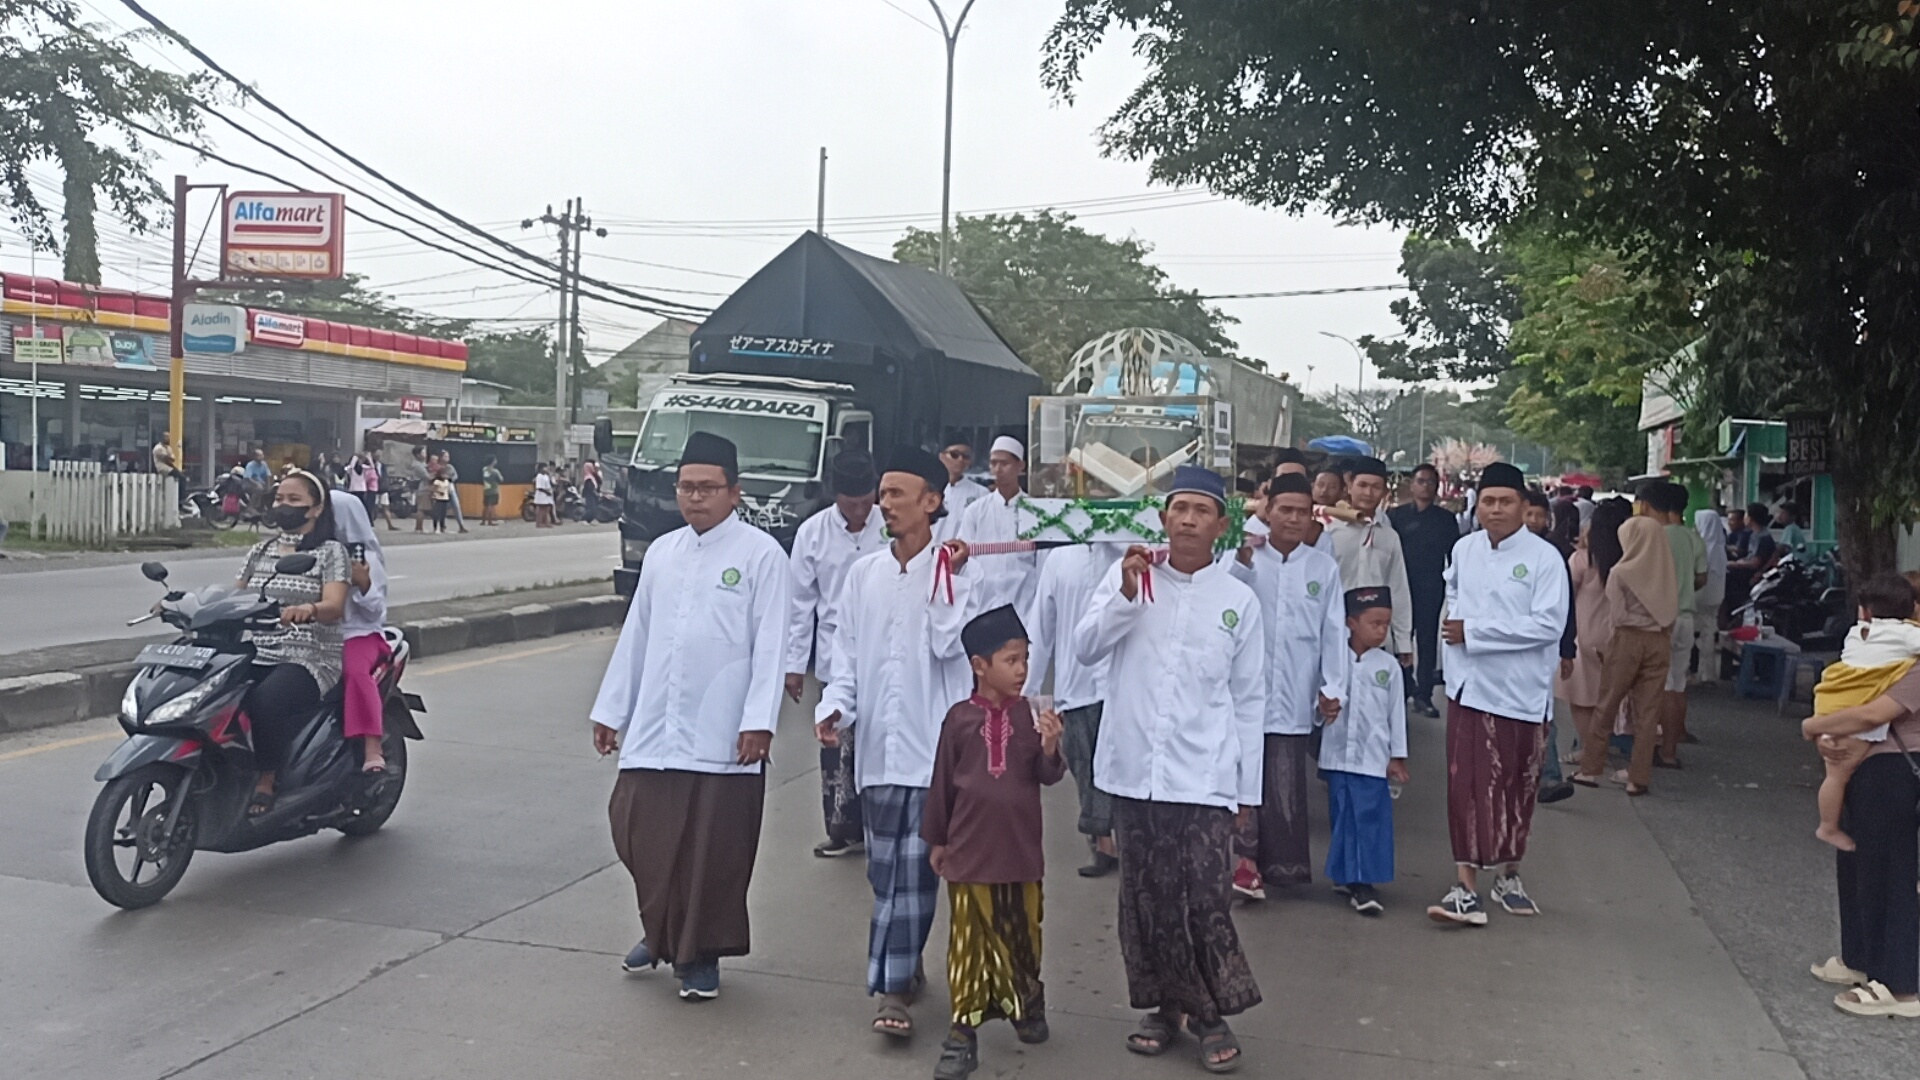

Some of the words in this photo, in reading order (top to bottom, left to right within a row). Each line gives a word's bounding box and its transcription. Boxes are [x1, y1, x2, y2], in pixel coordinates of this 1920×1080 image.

[234, 201, 325, 223] Alfamart
[190, 312, 231, 326] Aladin
[257, 316, 303, 333] Alfamart
[403, 400, 420, 411] ATM
[1789, 438, 1827, 461] BESI
